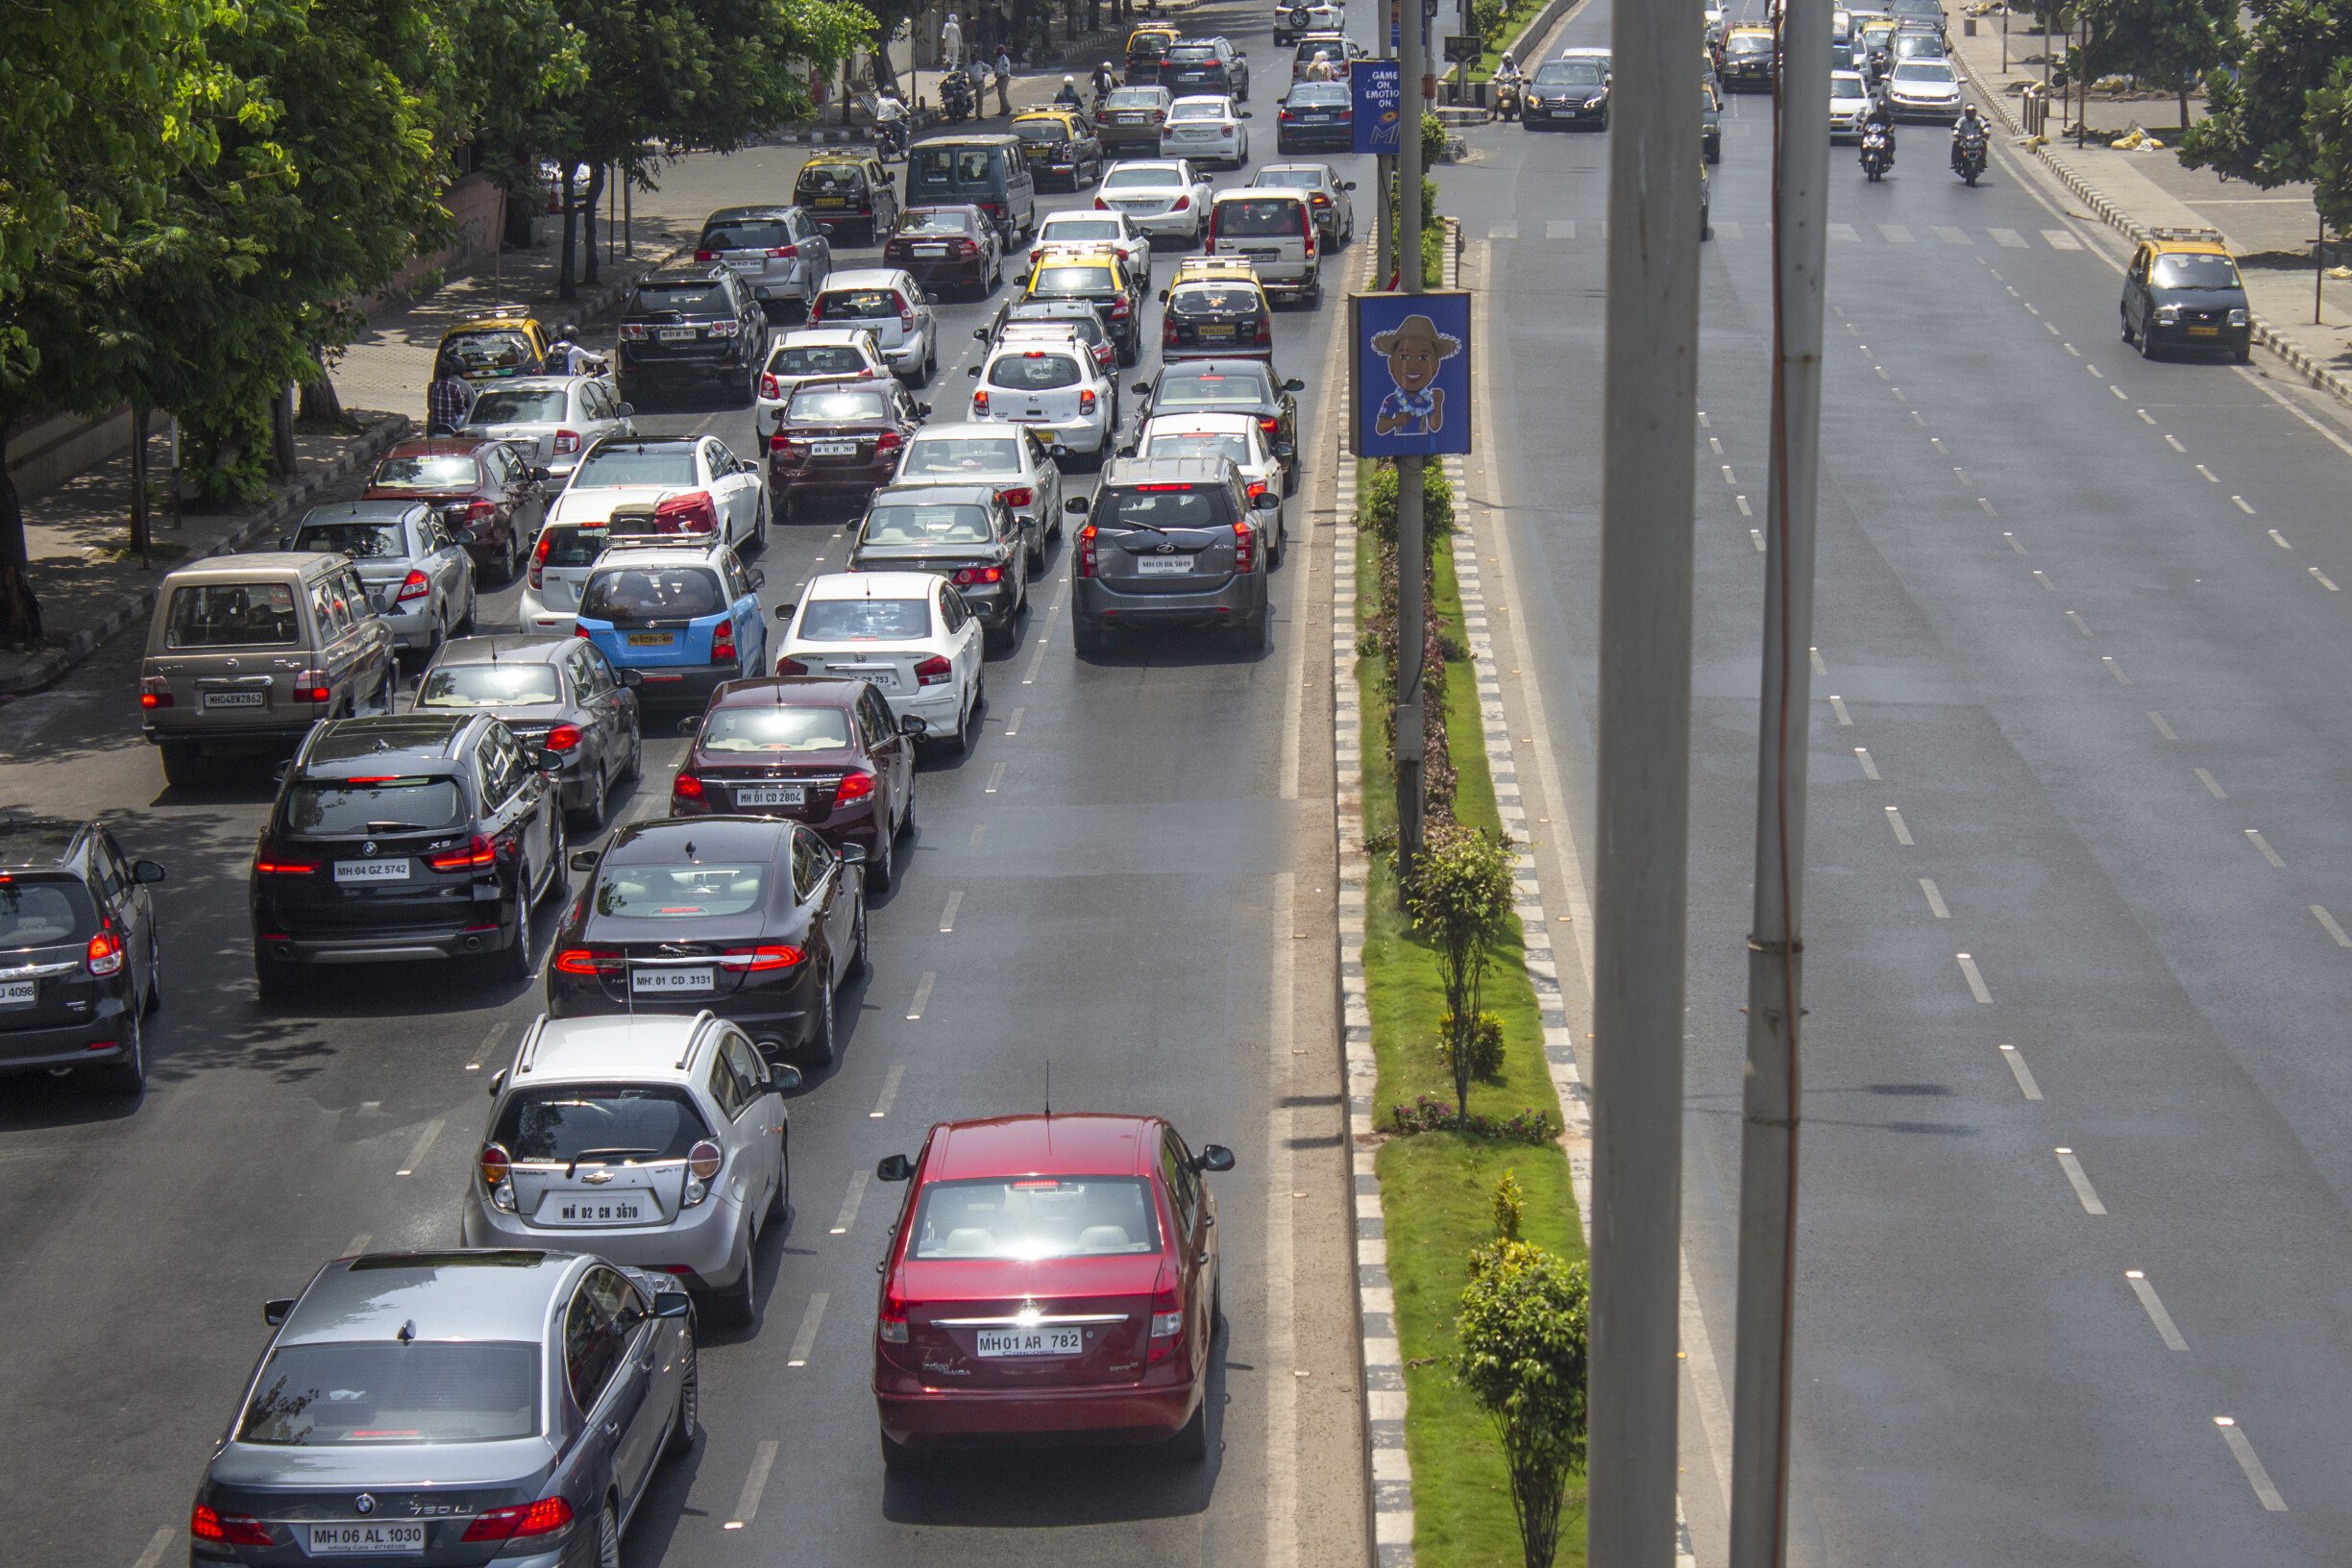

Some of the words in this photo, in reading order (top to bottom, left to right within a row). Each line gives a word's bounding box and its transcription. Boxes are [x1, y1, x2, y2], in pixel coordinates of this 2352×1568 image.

[1372, 71, 1398, 80] GAME
[1377, 81, 1392, 89] ON.
[1365, 89, 1400, 99] EMOTIO
[1379, 99, 1394, 108] ON.
[741, 794, 751, 803] MH
[754, 794, 763, 802] 01
[766, 793, 777, 802] CD
[779, 793, 801, 801] 2804
[429, 841, 452, 849] X5
[9, 987, 34, 997] 4098
[562, 1207, 576, 1219] MH
[581, 1207, 592, 1218] 02
[599, 1207, 610, 1218] CH
[616, 1206, 638, 1218] 3670
[1025, 1336, 1041, 1349] AR
[1050, 1335, 1079, 1348] 782
